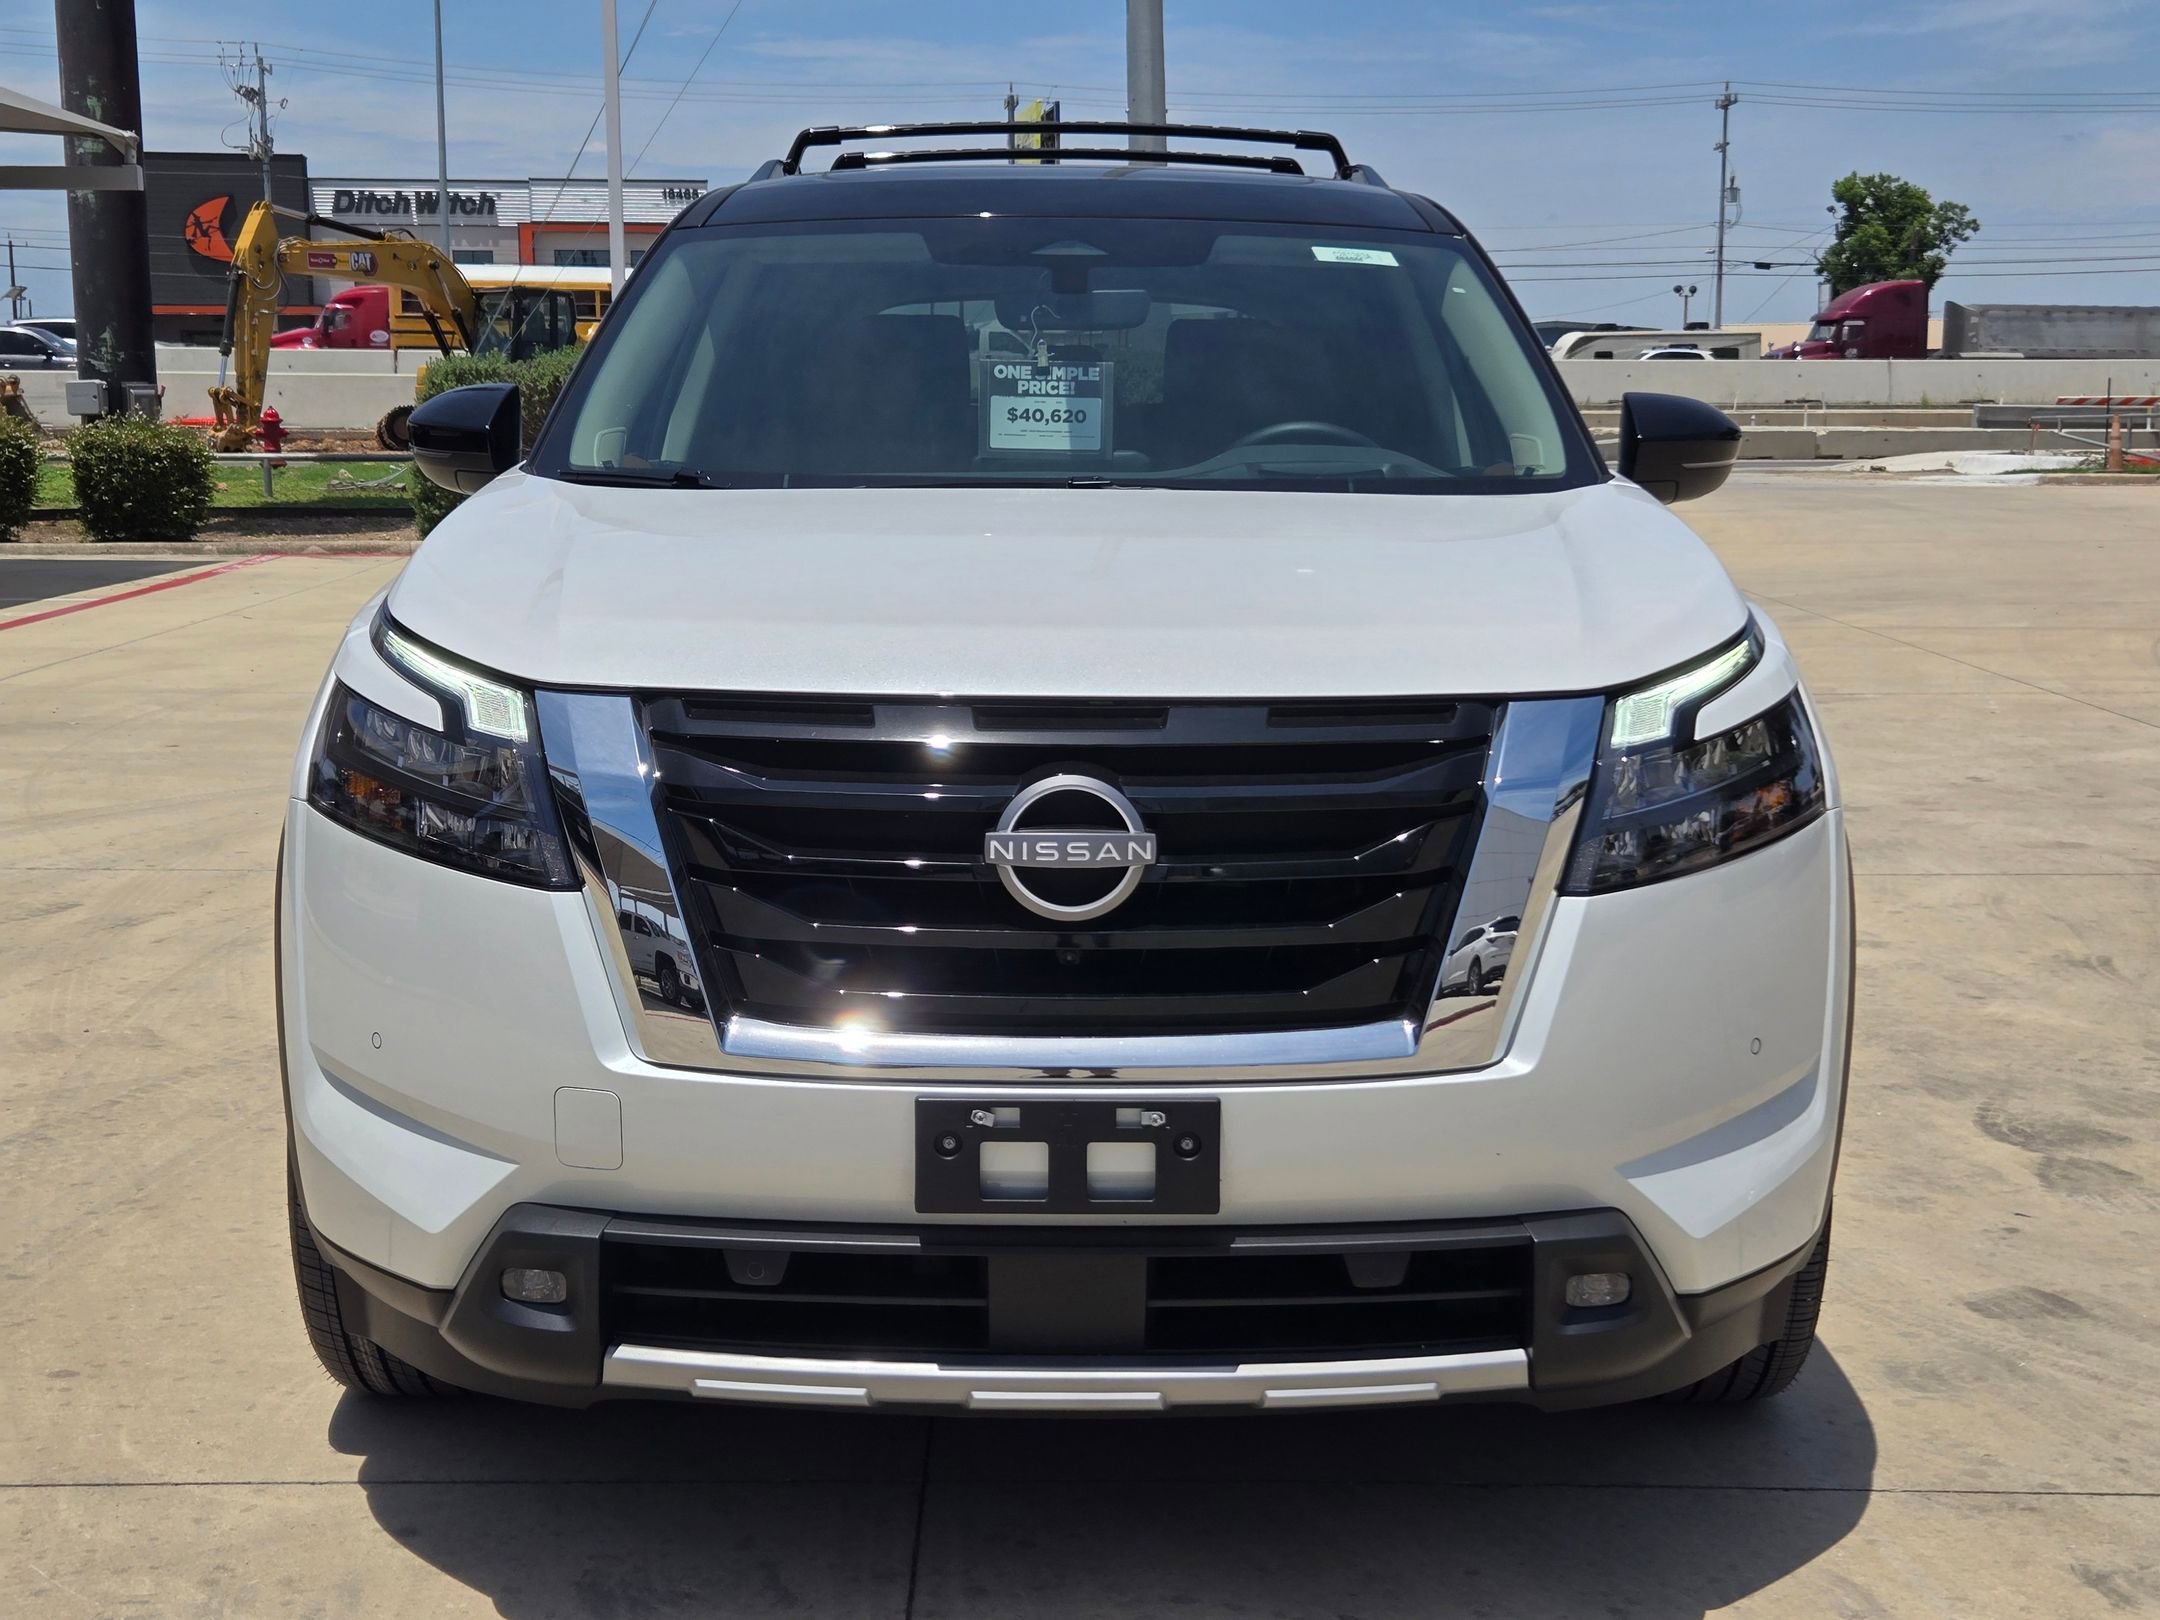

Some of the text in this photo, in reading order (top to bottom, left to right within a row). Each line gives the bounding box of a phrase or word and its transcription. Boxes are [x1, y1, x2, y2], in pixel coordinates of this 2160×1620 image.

[332, 190, 497, 215] Ditch Wtch
[351, 252, 371, 271] CAT
[993, 364, 1032, 380] ONE
[1017, 381, 1075, 395] PRICE!
[1007, 407, 1087, 426] $40,620
[989, 840, 1152, 861] NISSAN
